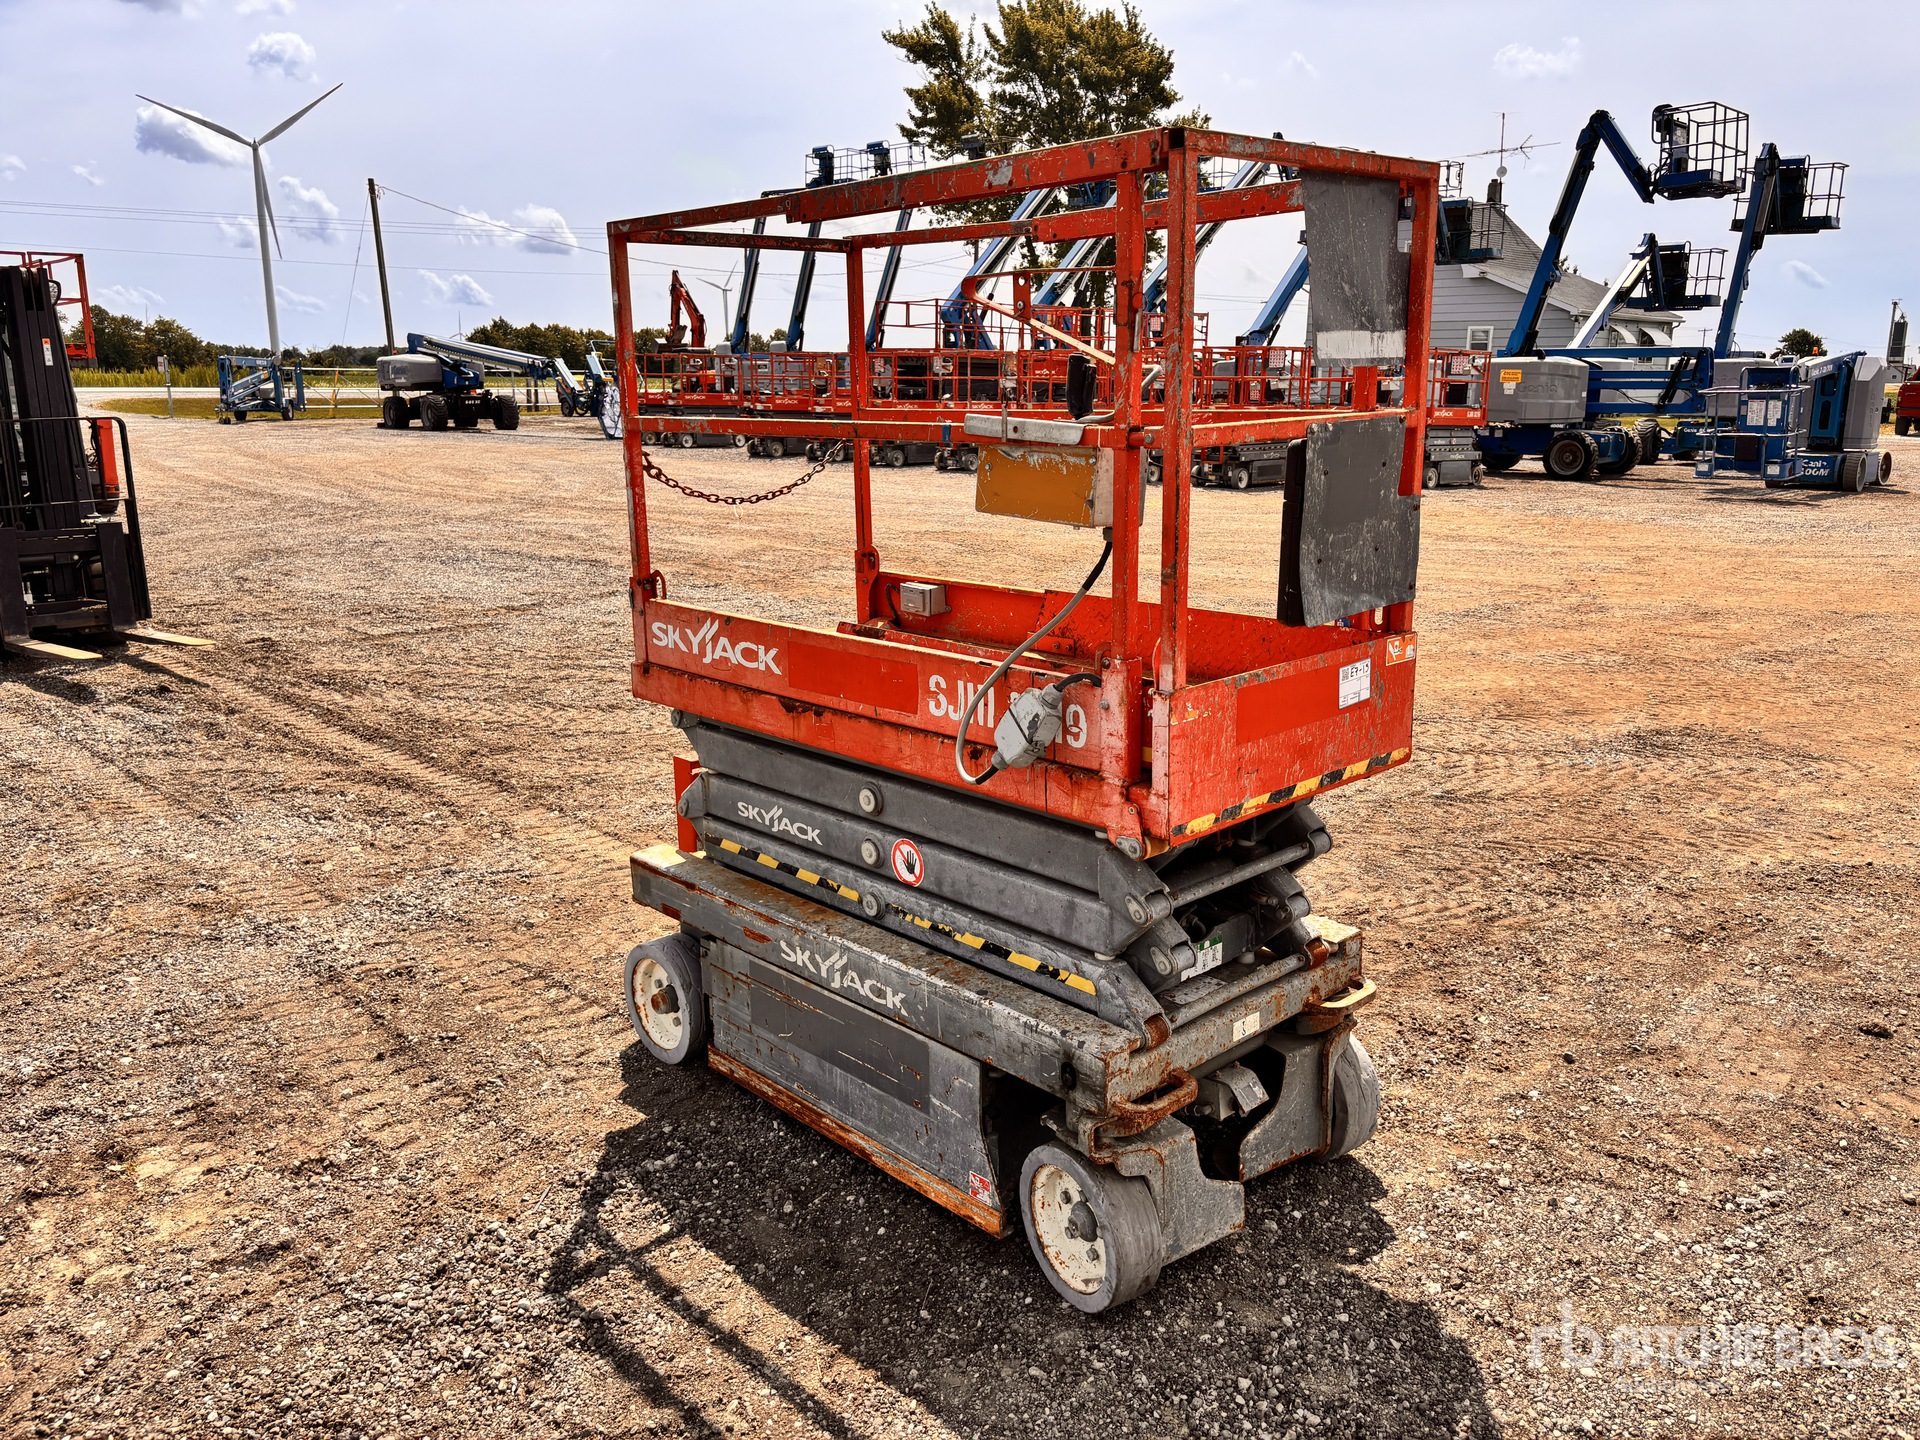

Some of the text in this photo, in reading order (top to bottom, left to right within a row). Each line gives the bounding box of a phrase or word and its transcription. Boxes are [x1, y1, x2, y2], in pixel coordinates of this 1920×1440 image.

[651, 617, 783, 676] SKYJACK
[737, 801, 824, 846] SKYJACK
[779, 939, 909, 1017] SKYJACK
